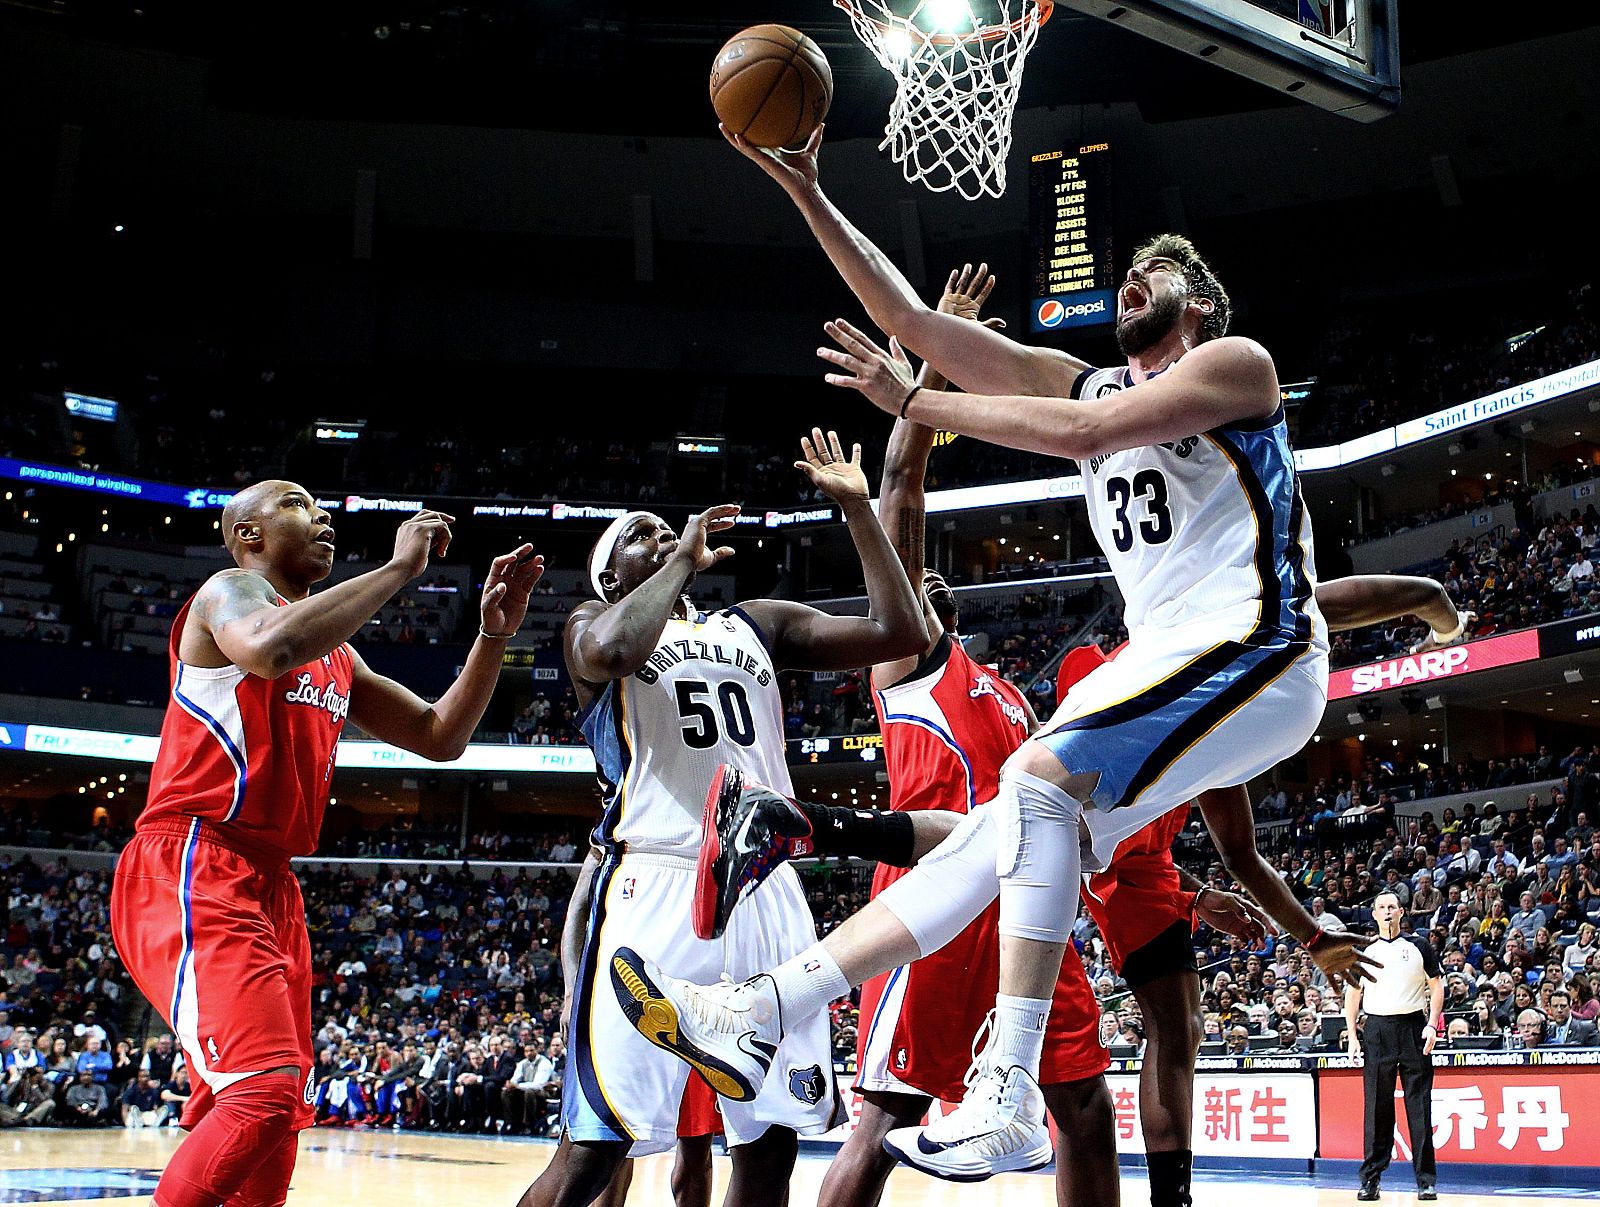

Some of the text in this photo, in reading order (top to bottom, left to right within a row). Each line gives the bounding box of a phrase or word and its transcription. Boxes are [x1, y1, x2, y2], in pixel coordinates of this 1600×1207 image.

[1079, 143, 1109, 154] CLIPPERS
[1031, 151, 1063, 162] GRIZZLIES
[1061, 158, 1079, 168] FG%
[1062, 170, 1079, 180] FT%
[1054, 184, 1061, 193] 3
[1061, 182, 1072, 192] PT
[1056, 193, 1085, 206] BLOCKS
[1057, 206, 1085, 218] STEALS
[1055, 217, 1087, 230] ASSISTS
[1049, 254, 1094, 268] TURNOVERS
[1048, 266, 1095, 281] PTS IN PAINT
[1049, 279, 1095, 293] FASTBREAK PTS
[1065, 300, 1106, 318] pepsi
[1424, 366, 1600, 433] Saint Francis Hospital
[19, 465, 142, 495] personalized wireless
[584, 506, 628, 519] TENNESSEE
[794, 509, 833, 522] TENNESSEE
[1106, 467, 1174, 553] 33
[634, 639, 772, 687] GRIZZLIES
[1351, 646, 1468, 693] SHARP
[286, 673, 320, 705] Los
[673, 680, 756, 749] 50
[810, 752, 819, 763] 2
[1195, 1057, 1302, 1069] cDonald's McDonald's
[1465, 1053, 1524, 1066] McDonald's
[1204, 1086, 1290, 1143] 新生
[1431, 1085, 1570, 1152] 乔丹
